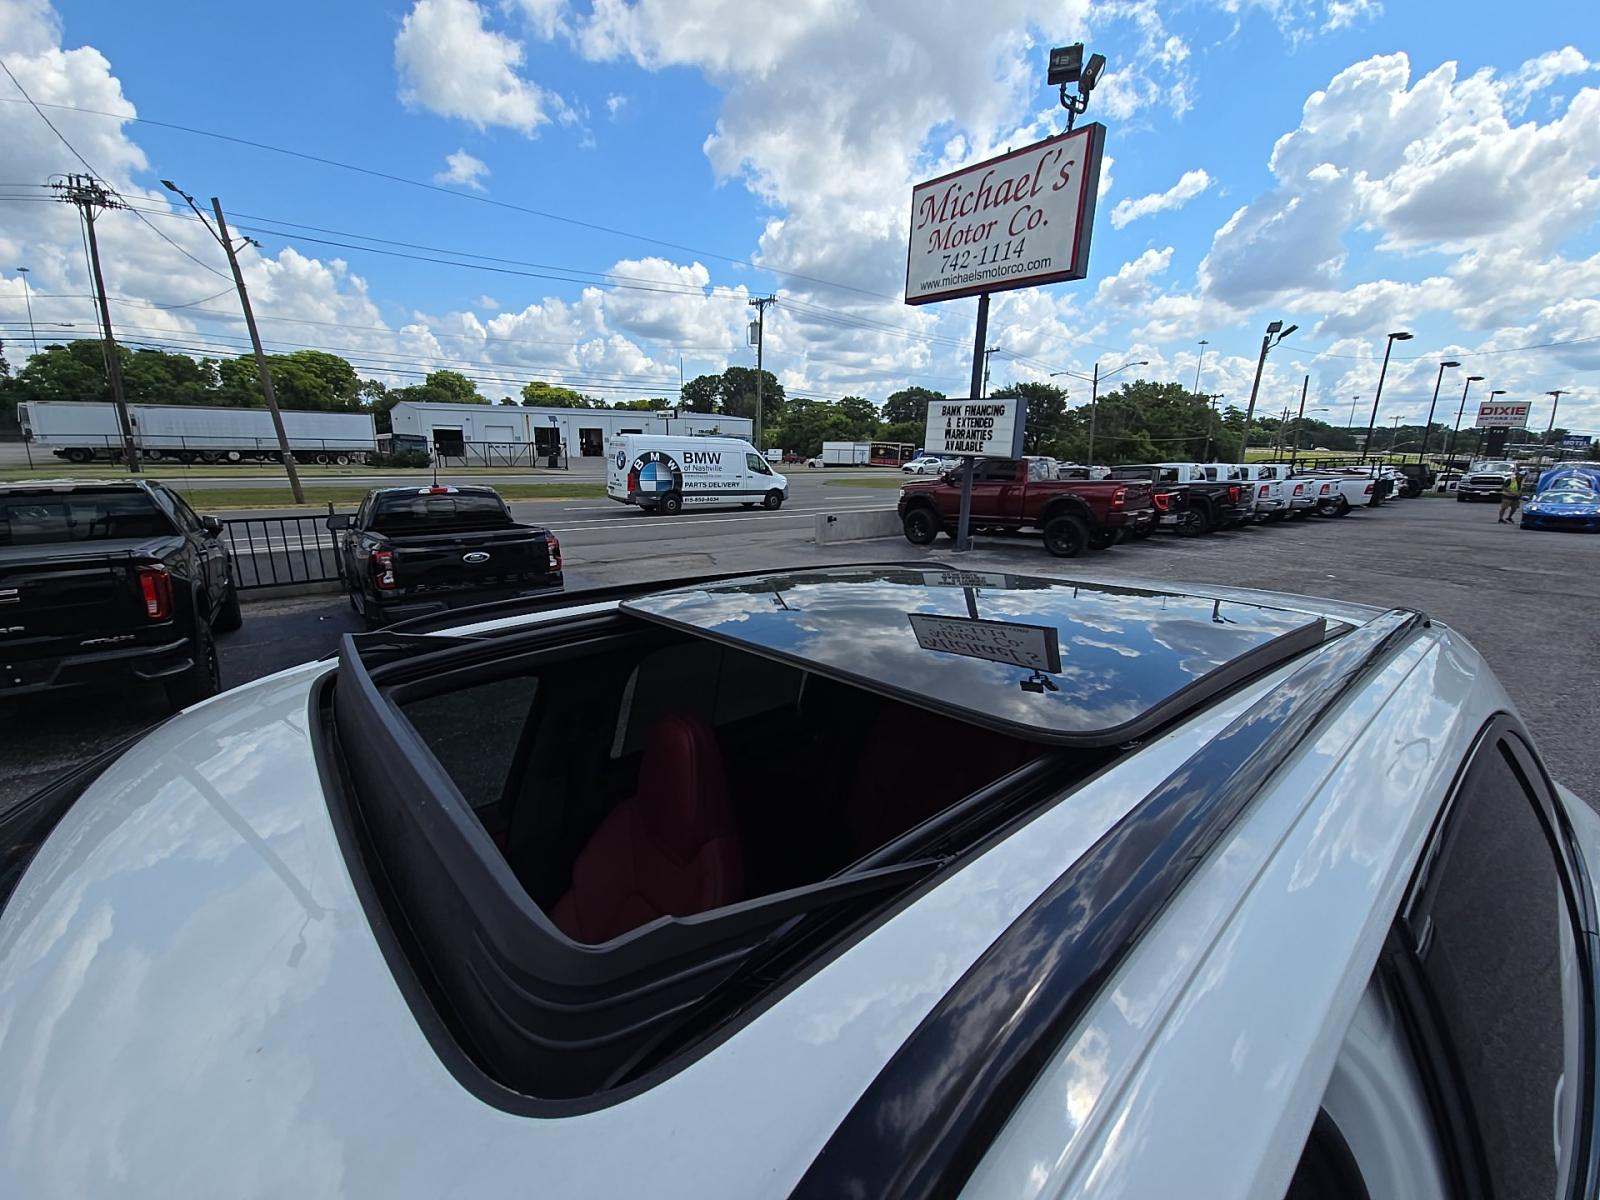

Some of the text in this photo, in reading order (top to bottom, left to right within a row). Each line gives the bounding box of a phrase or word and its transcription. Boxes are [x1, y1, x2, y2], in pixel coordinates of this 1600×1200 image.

[917, 147, 1075, 230] Michael's
[926, 204, 1048, 254] Motor Co.
[940, 237, 1026, 274] 742-1114
[920, 257, 1052, 291] www.michaelsmotorco.com
[941, 405, 1005, 416] BANK FINANCING
[1480, 406, 1527, 415] DIXIE
[946, 417, 994, 428] & EXTENDED
[944, 429, 993, 440] WARRANTIES
[944, 441, 984, 452] AVAILABLE
[683, 452, 721, 464] BMW
[692, 464, 723, 472] Nashville
